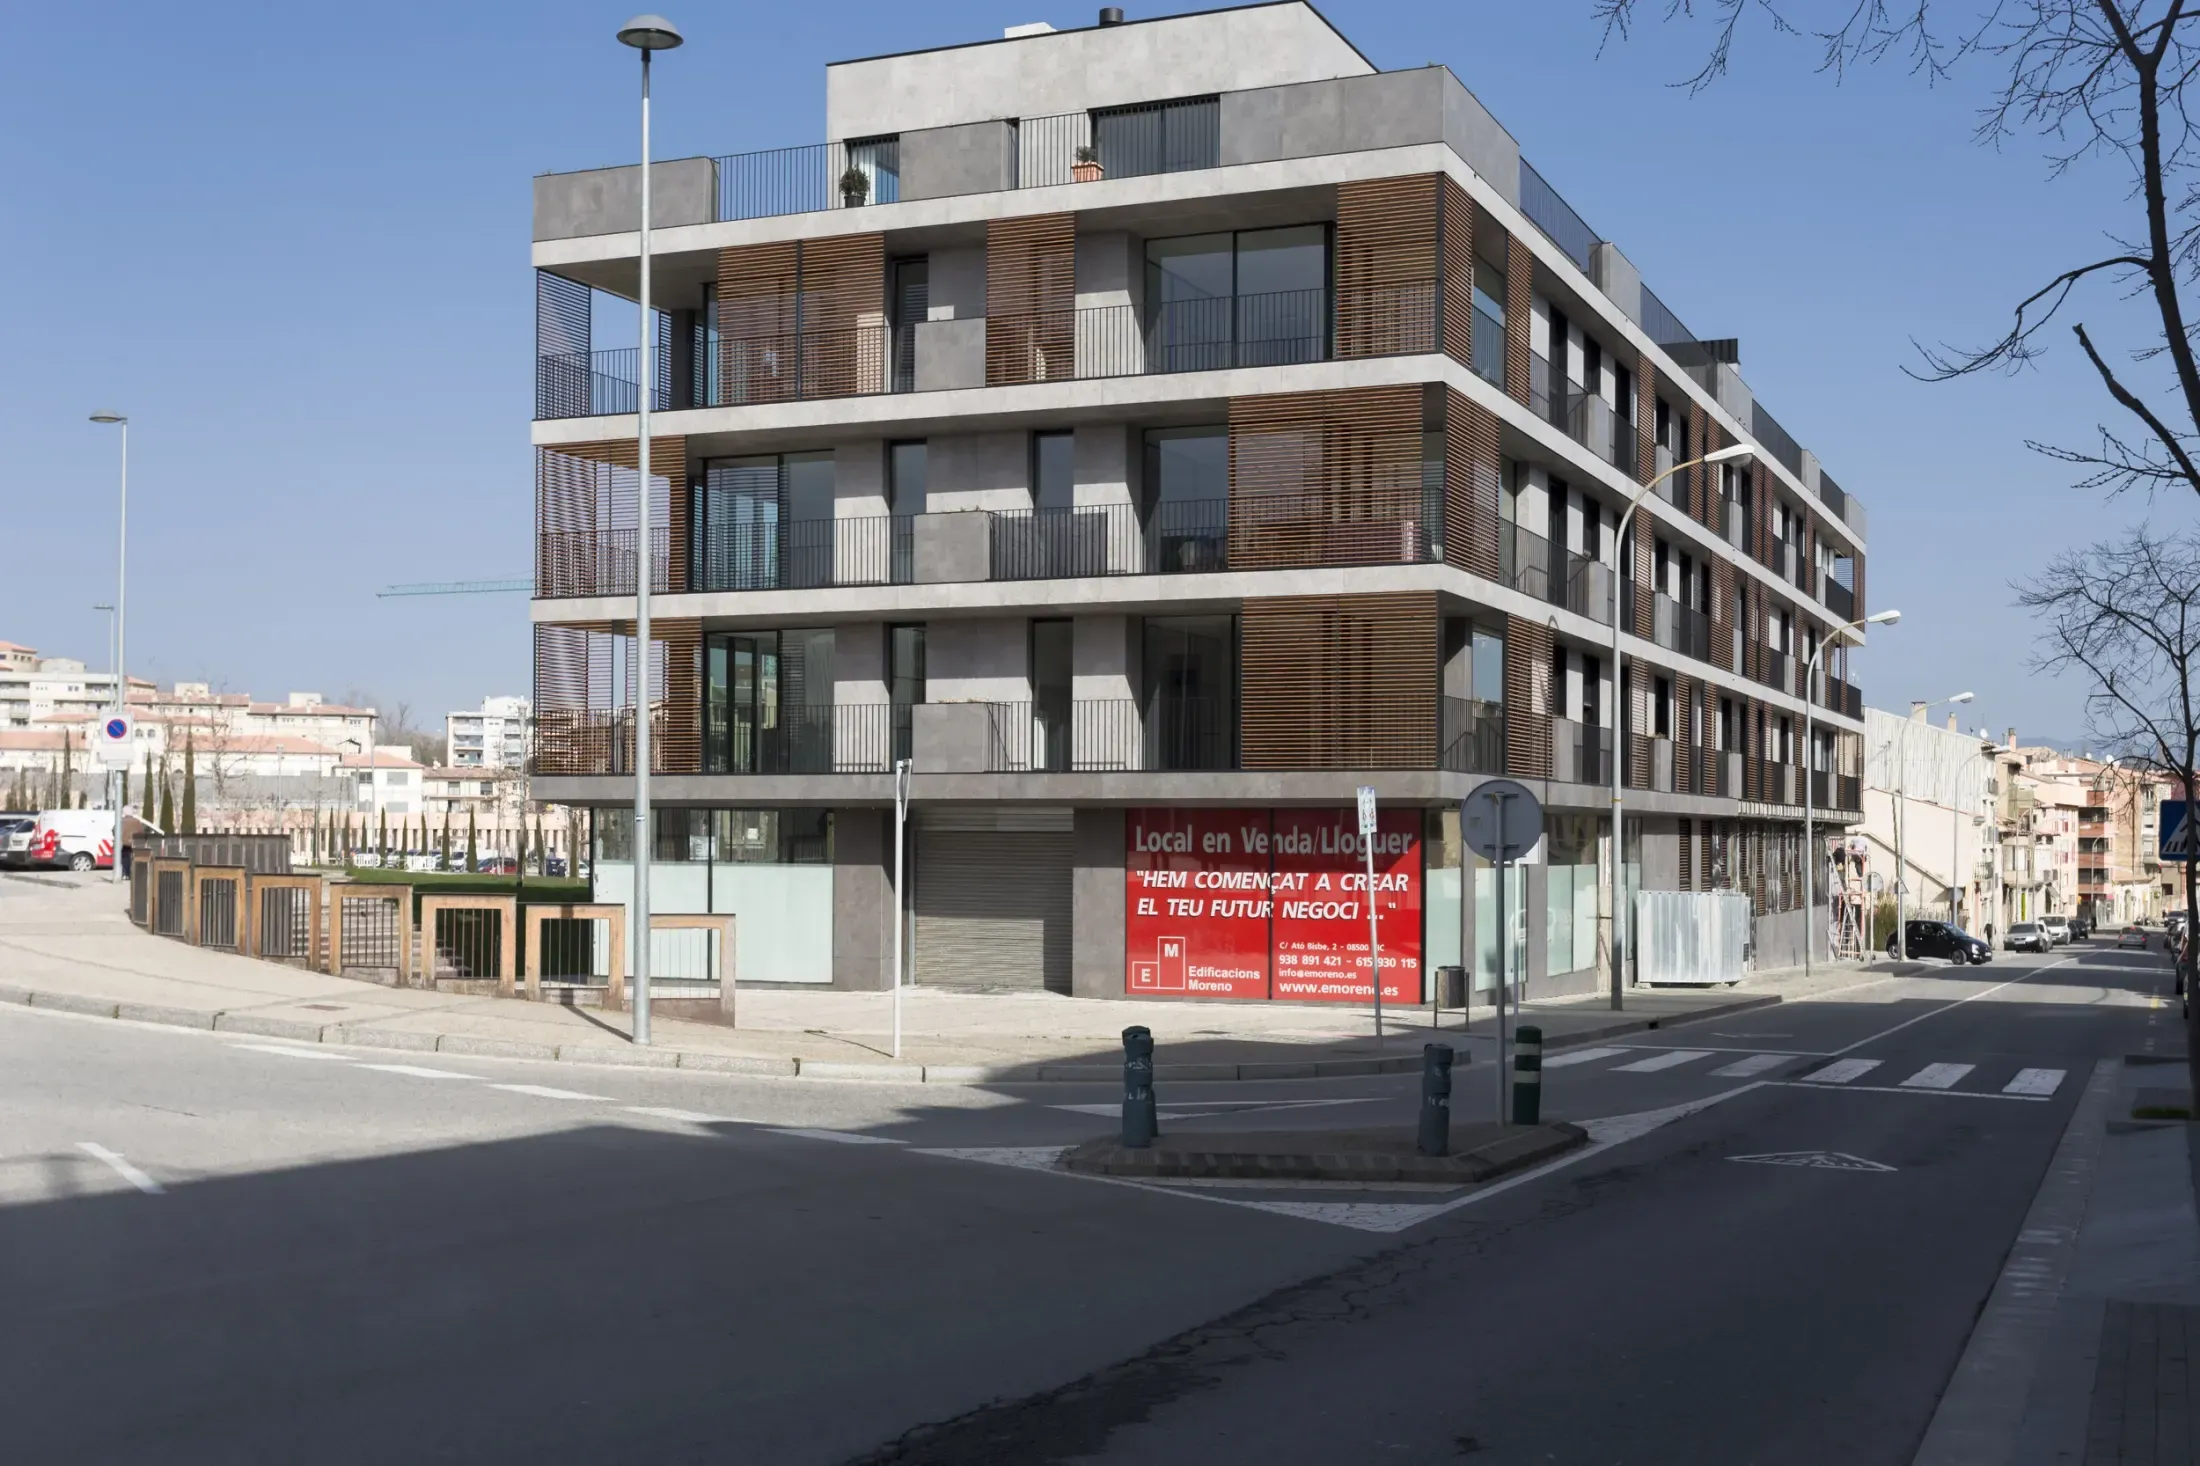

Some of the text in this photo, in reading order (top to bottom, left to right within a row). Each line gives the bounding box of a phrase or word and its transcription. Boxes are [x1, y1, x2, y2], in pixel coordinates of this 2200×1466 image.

[1136, 824, 1193, 853] Local
[1202, 832, 1231, 853] en
[1194, 871, 1309, 895] COMENÇAT
[1314, 873, 1331, 891] A
[1340, 873, 1409, 892] CREAR
[1137, 898, 1158, 915] EL
[1167, 899, 1204, 916] TEU
[1210, 900, 1274, 918] FUTUR
[1282, 901, 1359, 920] NEGOCI
[1164, 943, 1179, 957] M
[1279, 942, 1288, 950] C/
[1307, 942, 1330, 951] Bisbe,
[1346, 943, 1369, 951] 08500
[1279, 955, 1298, 965] 938
[1301, 955, 1320, 966] 891
[1323, 956, 1342, 966] 421
[1355, 957, 1373, 967] 615
[1377, 957, 1397, 968] 930
[1400, 958, 1417, 969] 115
[1141, 968, 1151, 982] E
[1188, 966, 1260, 979] Edificacions
[1279, 968, 1357, 979] info@emoreno.es
[1188, 979, 1233, 992] Moreno
